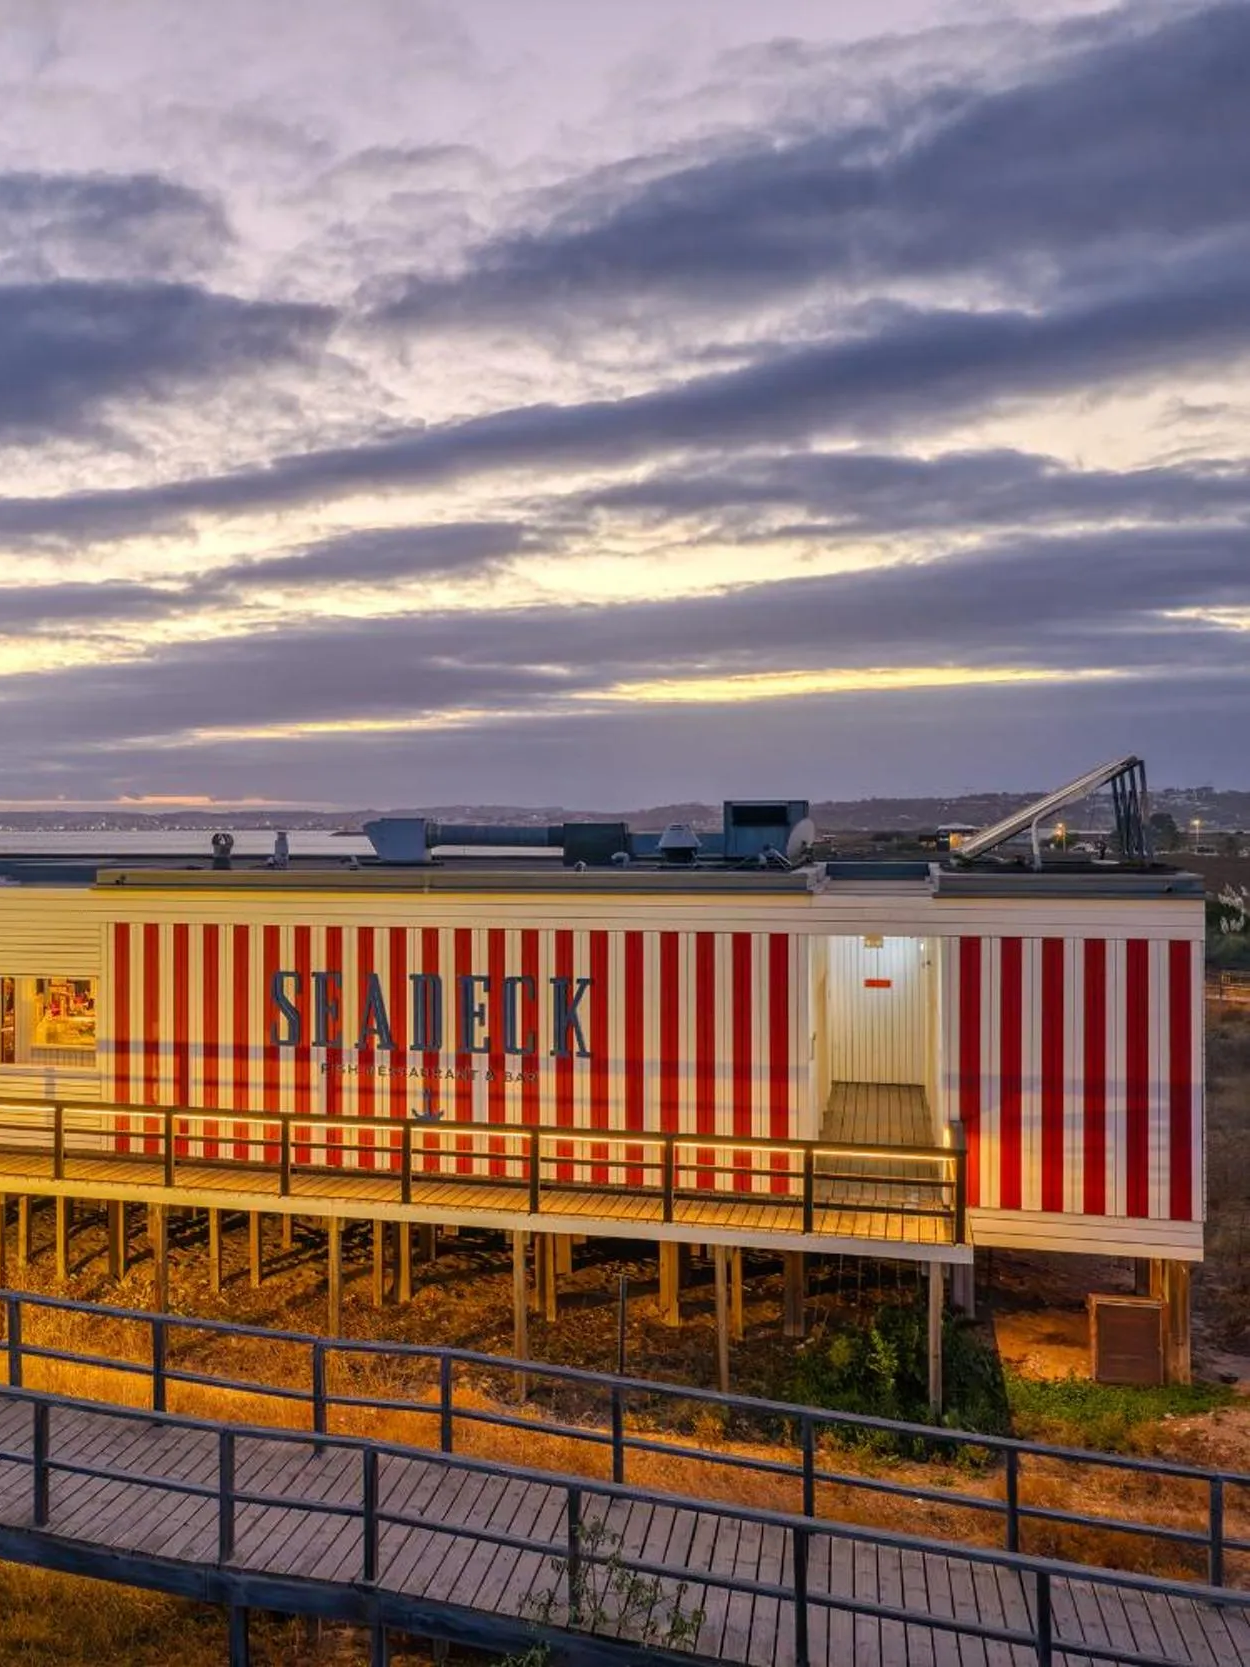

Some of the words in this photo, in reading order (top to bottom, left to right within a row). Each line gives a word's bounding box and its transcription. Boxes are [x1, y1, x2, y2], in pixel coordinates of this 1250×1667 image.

[269, 971, 594, 1059] SEADECK
[320, 1063, 358, 1077] FSH
[366, 1065, 480, 1081] EAURANT
